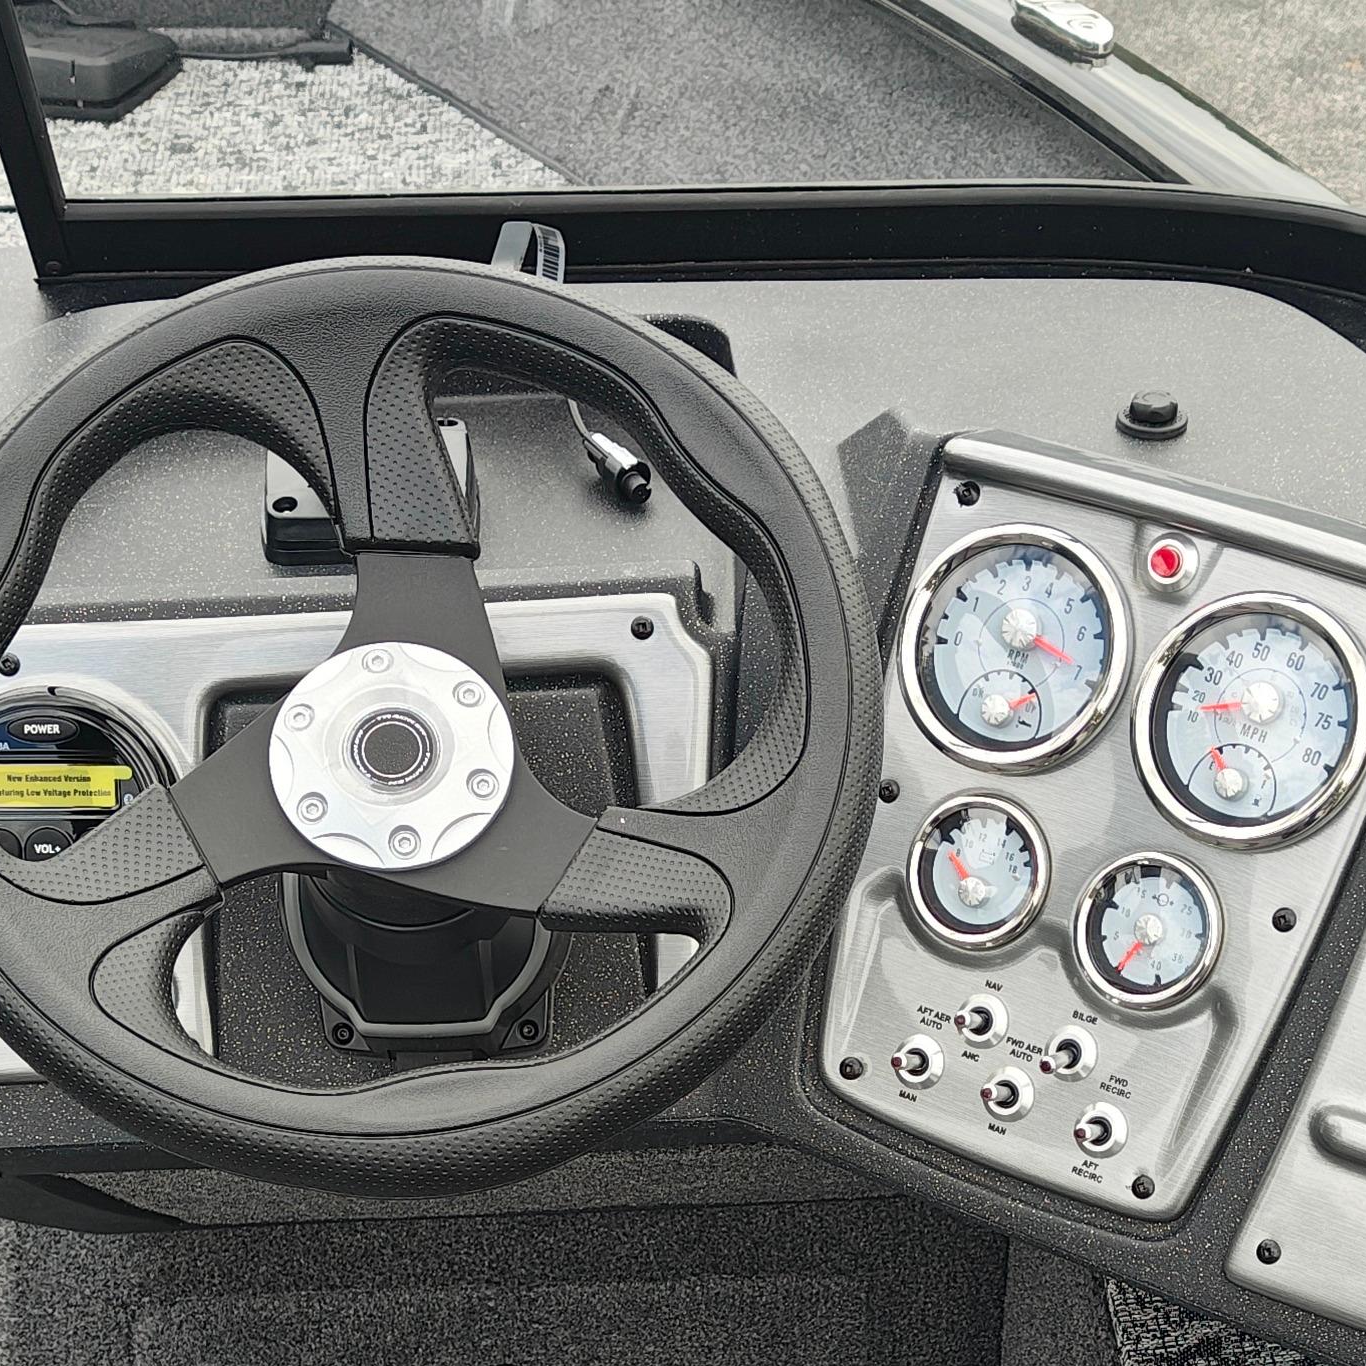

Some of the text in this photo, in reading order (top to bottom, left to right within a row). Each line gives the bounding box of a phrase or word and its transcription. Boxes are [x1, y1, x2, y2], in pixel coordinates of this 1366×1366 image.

[997, 580, 1006, 595] 2
[1022, 576, 1032, 591] 3
[1045, 583, 1053, 598] 4
[973, 597, 979, 612] 1
[1065, 598, 1075, 614] 5
[954, 631, 962, 646] 0
[1077, 626, 1087, 641] 6
[1007, 649, 1029, 664] RPM
[1226, 652, 1244, 668] 40
[1252, 643, 1270, 662] 50
[1287, 652, 1305, 671] 60
[1074, 665, 1082, 680] 7
[1205, 667, 1223, 686] 30
[1192, 690, 1206, 703] 20
[1310, 683, 1329, 701] 70
[1187, 710, 1199, 722] 10
[1315, 712, 1332, 730] 75
[23, 723, 61, 735] POWER
[1240, 723, 1268, 744] MPH
[1302, 748, 1322, 766] 80
[7, 774, 91, 783] New Enhanced Version
[41, 788, 71, 799] Voltage
[965, 840, 974, 848] 10
[979, 833, 987, 842] 12
[1006, 852, 1014, 861] 16
[1151, 961, 1162, 971] 40
[985, 980, 1003, 992] NAV
[917, 1005, 952, 1024] AFT AER
[1072, 1010, 1098, 1025] BILGE
[919, 1017, 943, 1030] AUTO
[1006, 1037, 1043, 1056] FWD AER
[961, 1050, 980, 1062] ANC
[1009, 1049, 1033, 1062] AUTO
[1109, 1074, 1129, 1088] FWD
[899, 1090, 918, 1102] MAN
[1099, 1082, 1132, 1100] RECIRC
[988, 1123, 1007, 1135] MAN
[1081, 1159, 1100, 1171] AFT
[1071, 1166, 1104, 1184] RECIRC
